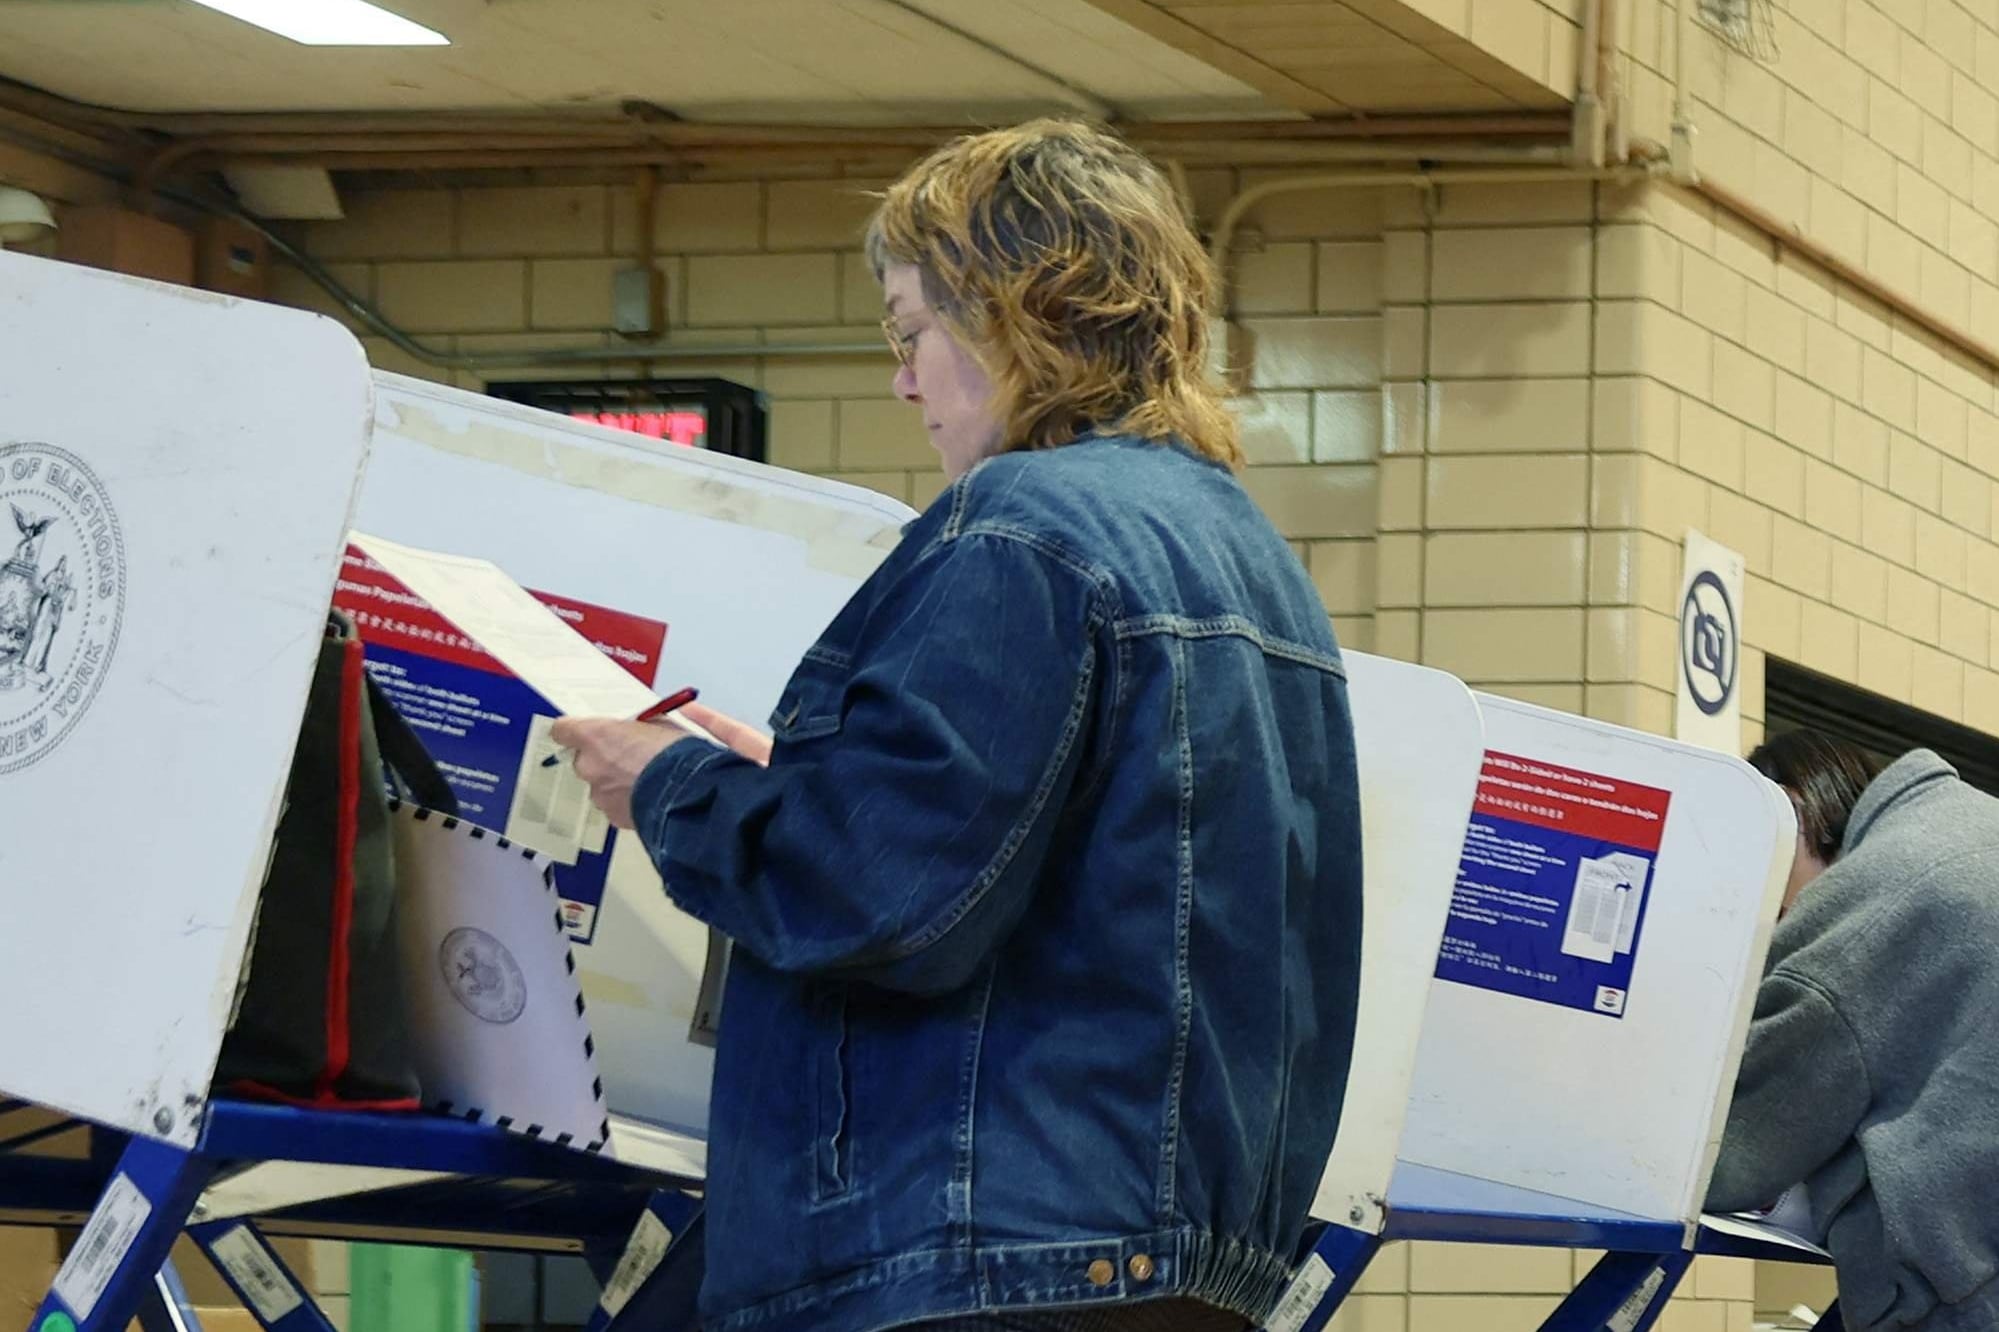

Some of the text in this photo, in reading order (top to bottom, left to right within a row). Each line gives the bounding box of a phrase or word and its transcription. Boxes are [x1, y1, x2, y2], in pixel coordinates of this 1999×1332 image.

[12, 457, 115, 600] OF ELECTIONS
[52, 641, 103, 718] YORK
